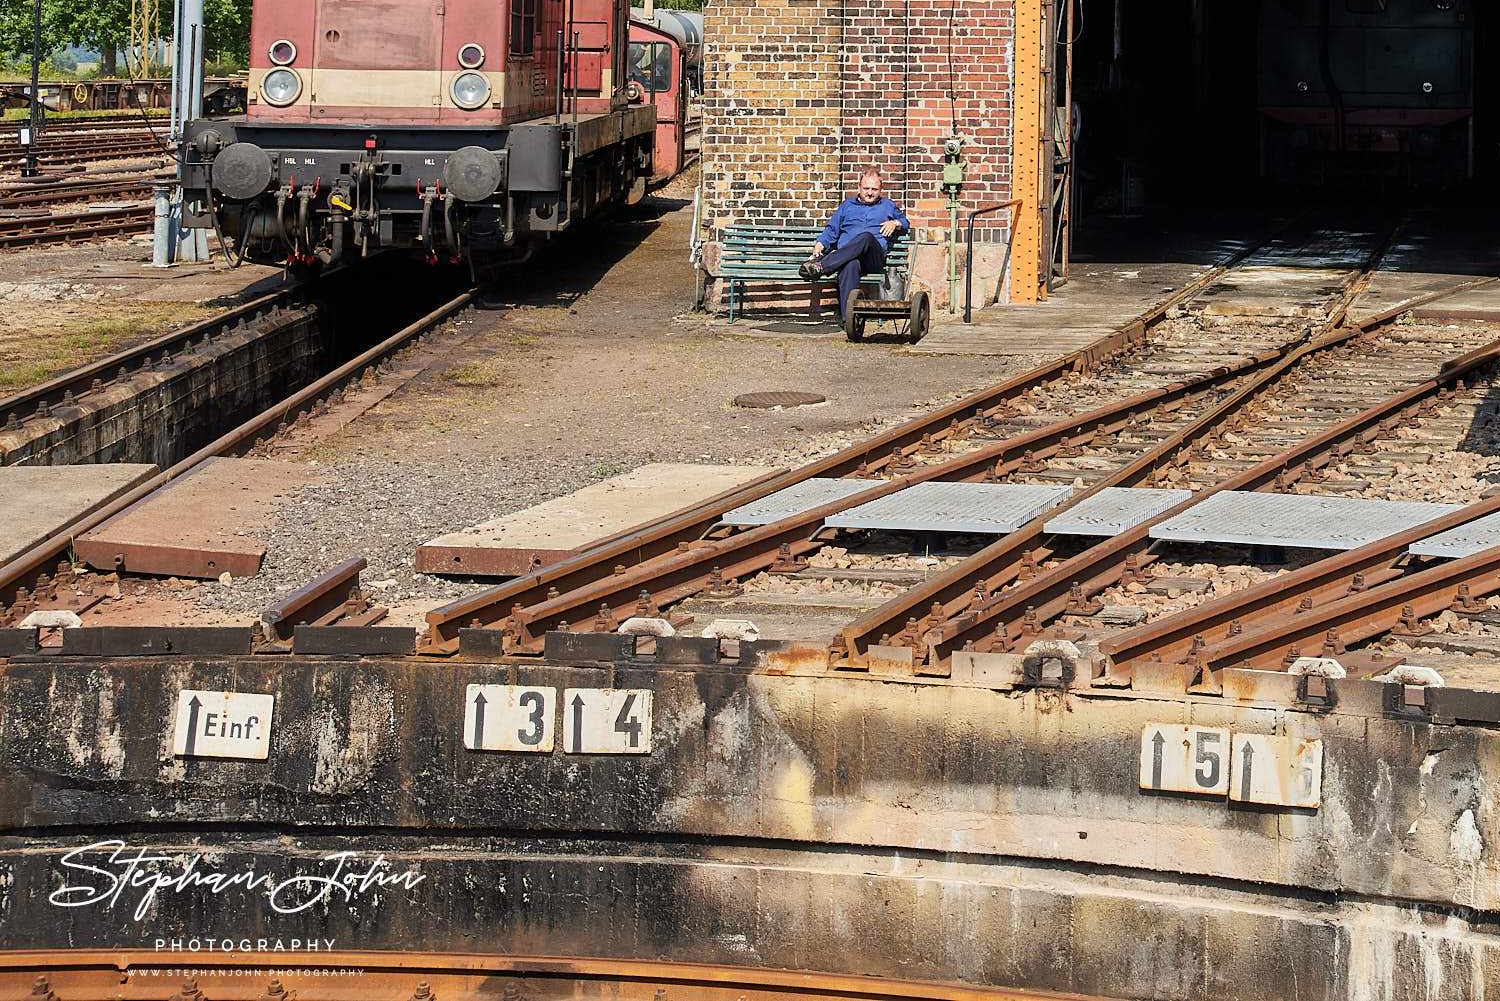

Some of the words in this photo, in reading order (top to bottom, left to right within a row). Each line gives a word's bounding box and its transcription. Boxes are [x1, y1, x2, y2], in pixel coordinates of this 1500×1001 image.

[204, 713, 261, 740] Einf.
[517, 691, 545, 746] 3
[614, 693, 642, 748] 4
[1195, 731, 1221, 788] 5
